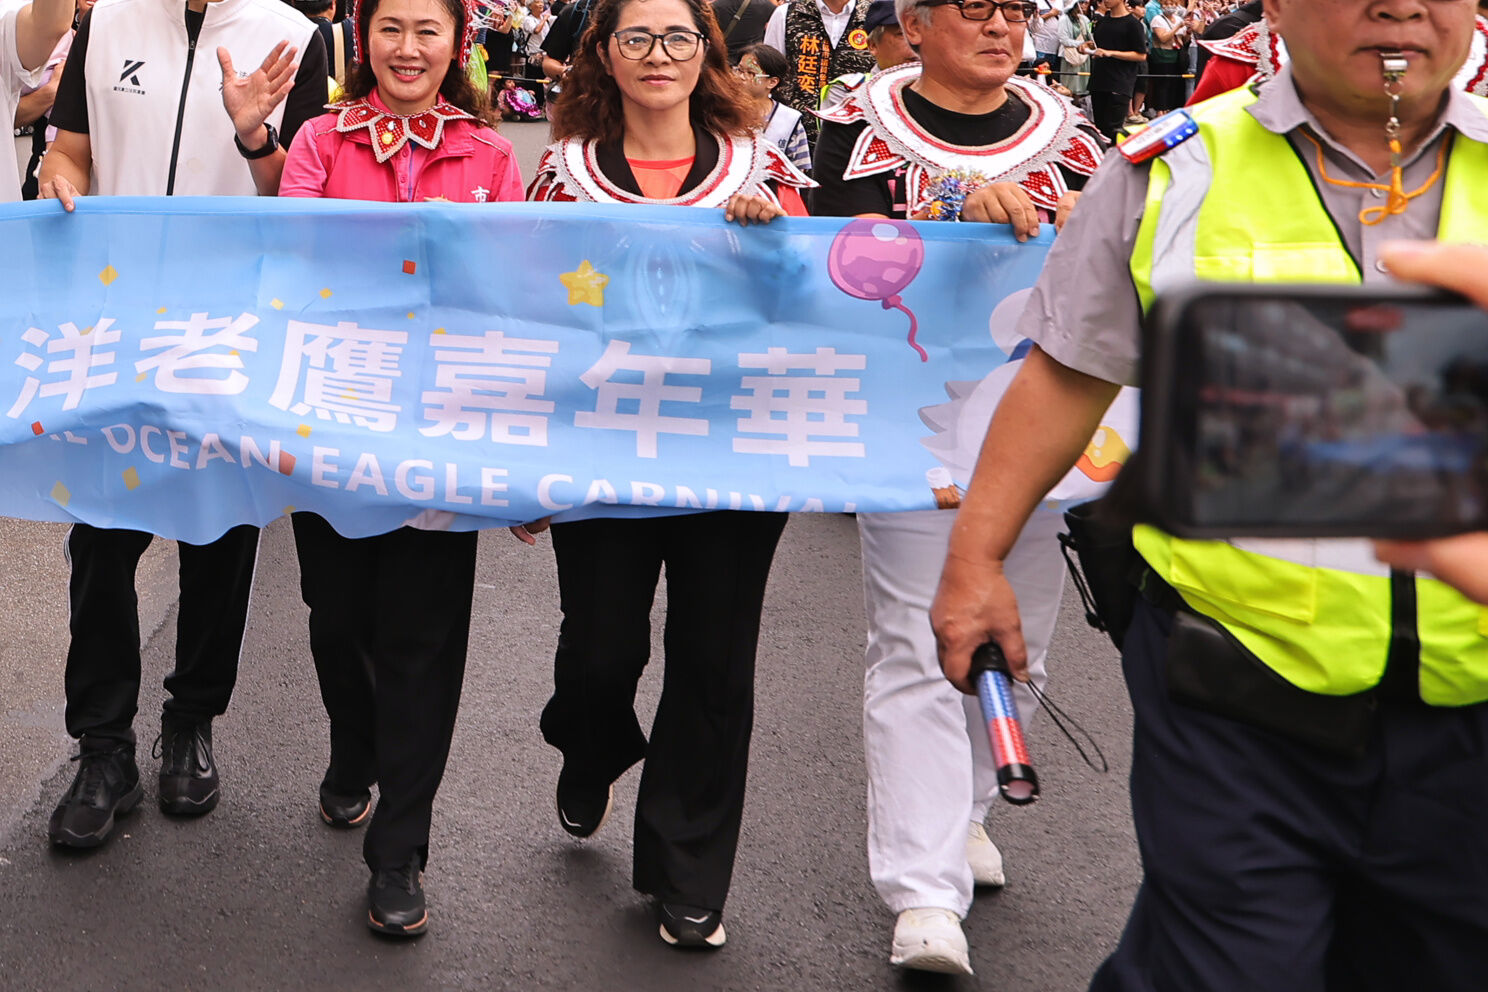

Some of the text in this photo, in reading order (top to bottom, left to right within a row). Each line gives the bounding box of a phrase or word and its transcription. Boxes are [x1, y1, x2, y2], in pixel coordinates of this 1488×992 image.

[797, 34, 821, 94] 林廷奕
[100, 422, 281, 473] OCEAN
[312, 444, 510, 508] EAGLE
